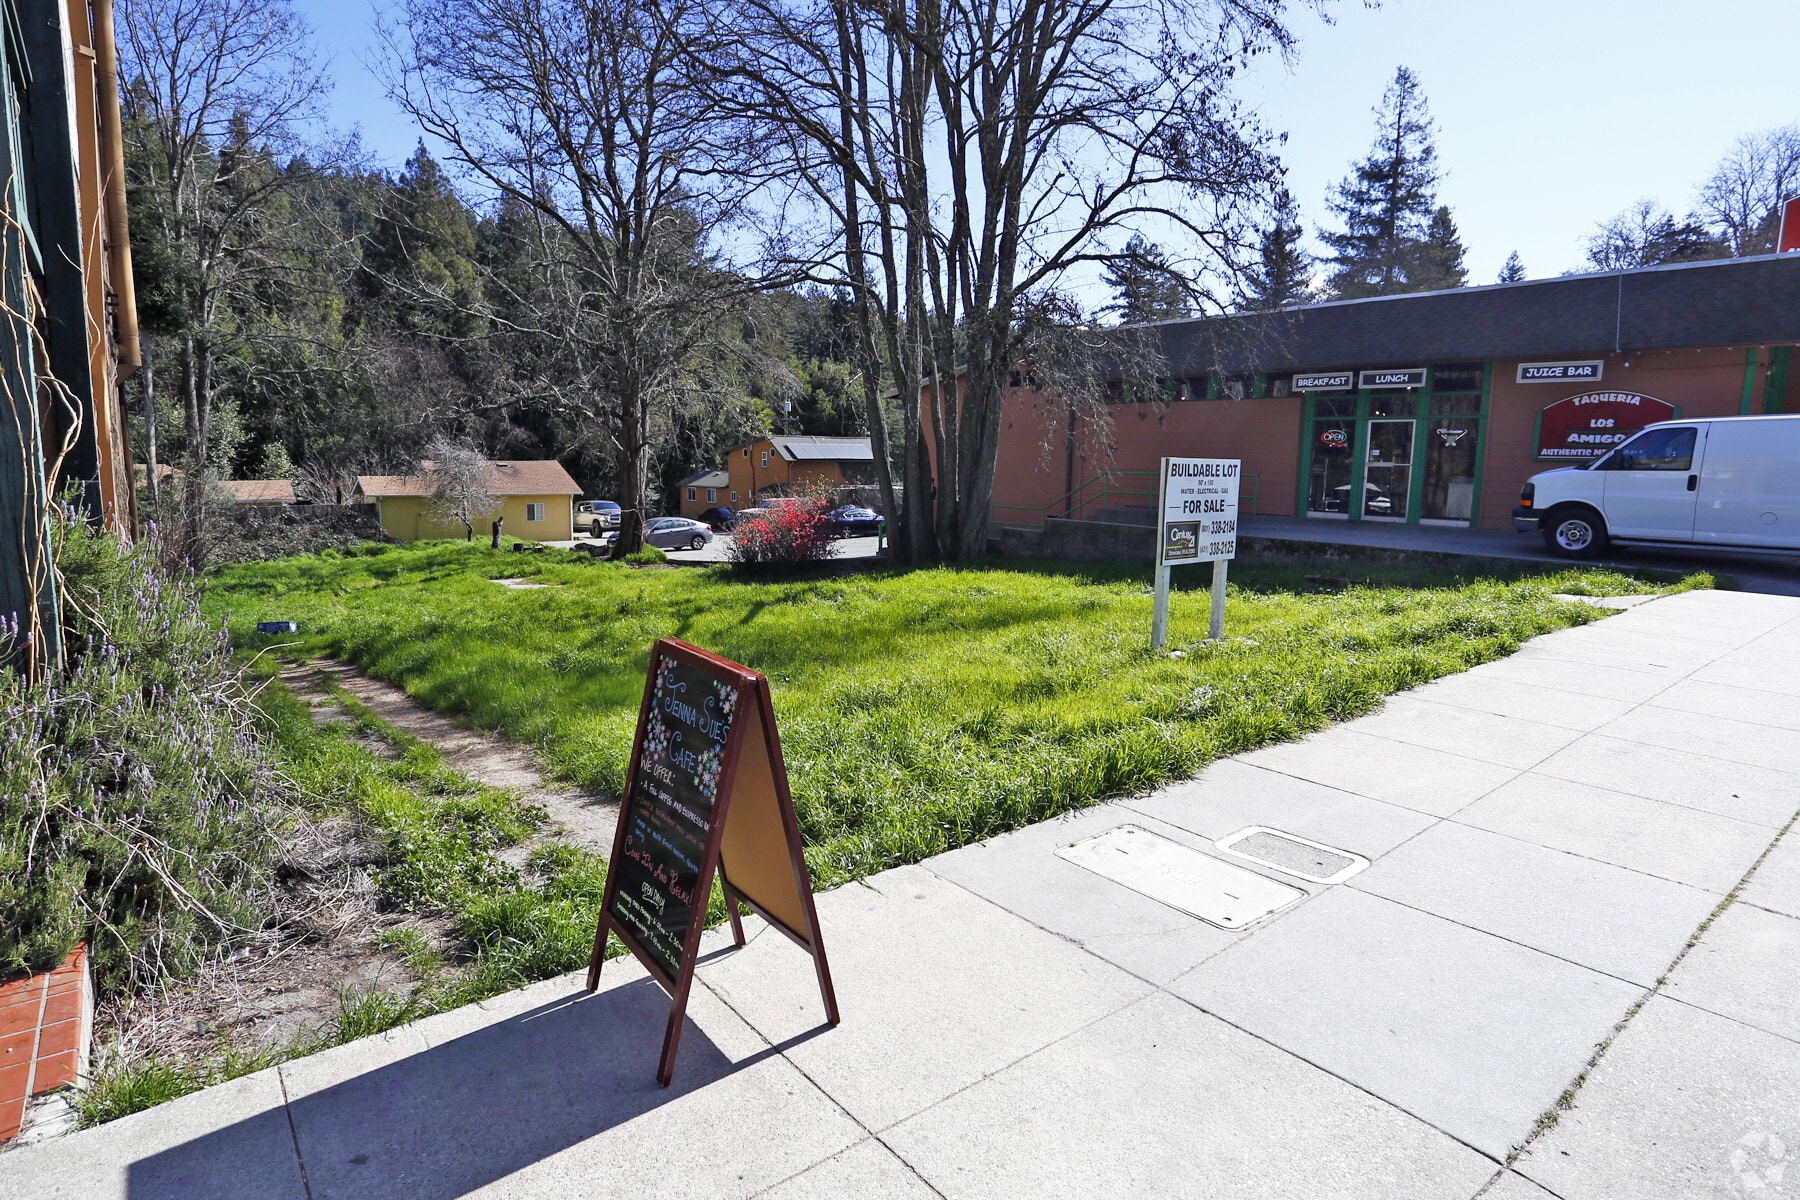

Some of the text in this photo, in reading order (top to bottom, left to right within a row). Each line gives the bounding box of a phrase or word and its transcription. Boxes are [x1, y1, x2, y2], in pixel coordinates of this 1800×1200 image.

[1526, 366, 1592, 377] JUICE BAR
[1298, 377, 1347, 386] BREAKFAST
[1376, 374, 1408, 383] LUNCH
[1572, 393, 1641, 406] TAQUERIA
[1590, 419, 1614, 428] LOS
[1567, 434, 1626, 443] AMIGO
[1171, 464, 1238, 477] BUILDABLE LOT
[1183, 500, 1225, 513] FOR SALE
[1171, 528, 1192, 541] Century
[664, 674, 696, 727] JENNA
[669, 731, 696, 774] CAFE
[640, 754, 652, 772] WE
[643, 780, 648, 790] A
[658, 790, 672, 806] COFFEE
[673, 801, 682, 812] AND
[624, 834, 640, 861] COME
[641, 851, 654, 872] IN
[654, 864, 667, 884] AND
[642, 882, 654, 898] OPEN
